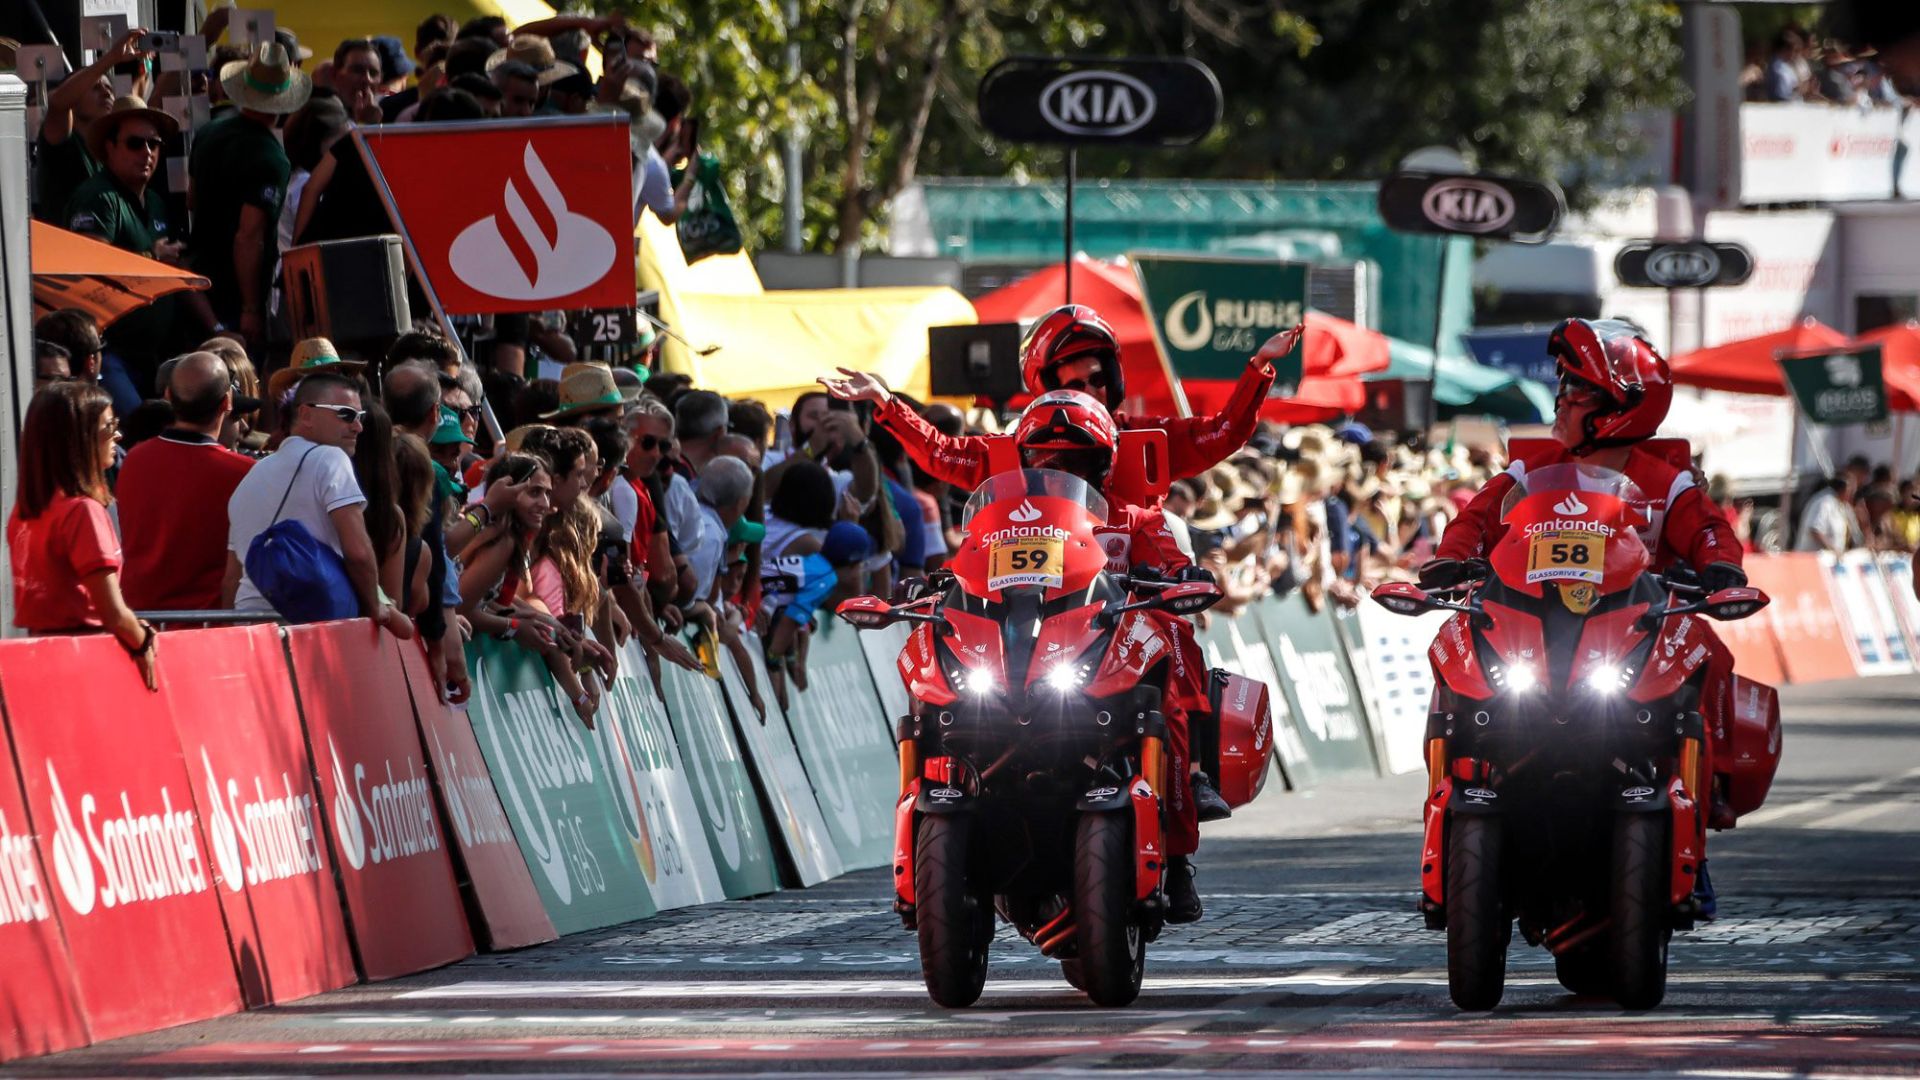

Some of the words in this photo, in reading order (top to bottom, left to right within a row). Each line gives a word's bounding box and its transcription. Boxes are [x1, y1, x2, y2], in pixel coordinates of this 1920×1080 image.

[1060, 84, 1137, 123] KIA
[1438, 189, 1500, 222] KIA
[592, 313, 621, 342] 25
[981, 524, 1072, 548] Santander
[1523, 517, 1617, 538] Santander
[1011, 549, 1049, 570] 59
[1551, 543, 1590, 565] 58
[990, 576, 1037, 588] GLASSDRIVE
[1528, 570, 1578, 581] GLASSDRIVE
[354, 755, 440, 865] Santander
[227, 771, 323, 886] Santander
[80, 786, 208, 909] Santander
